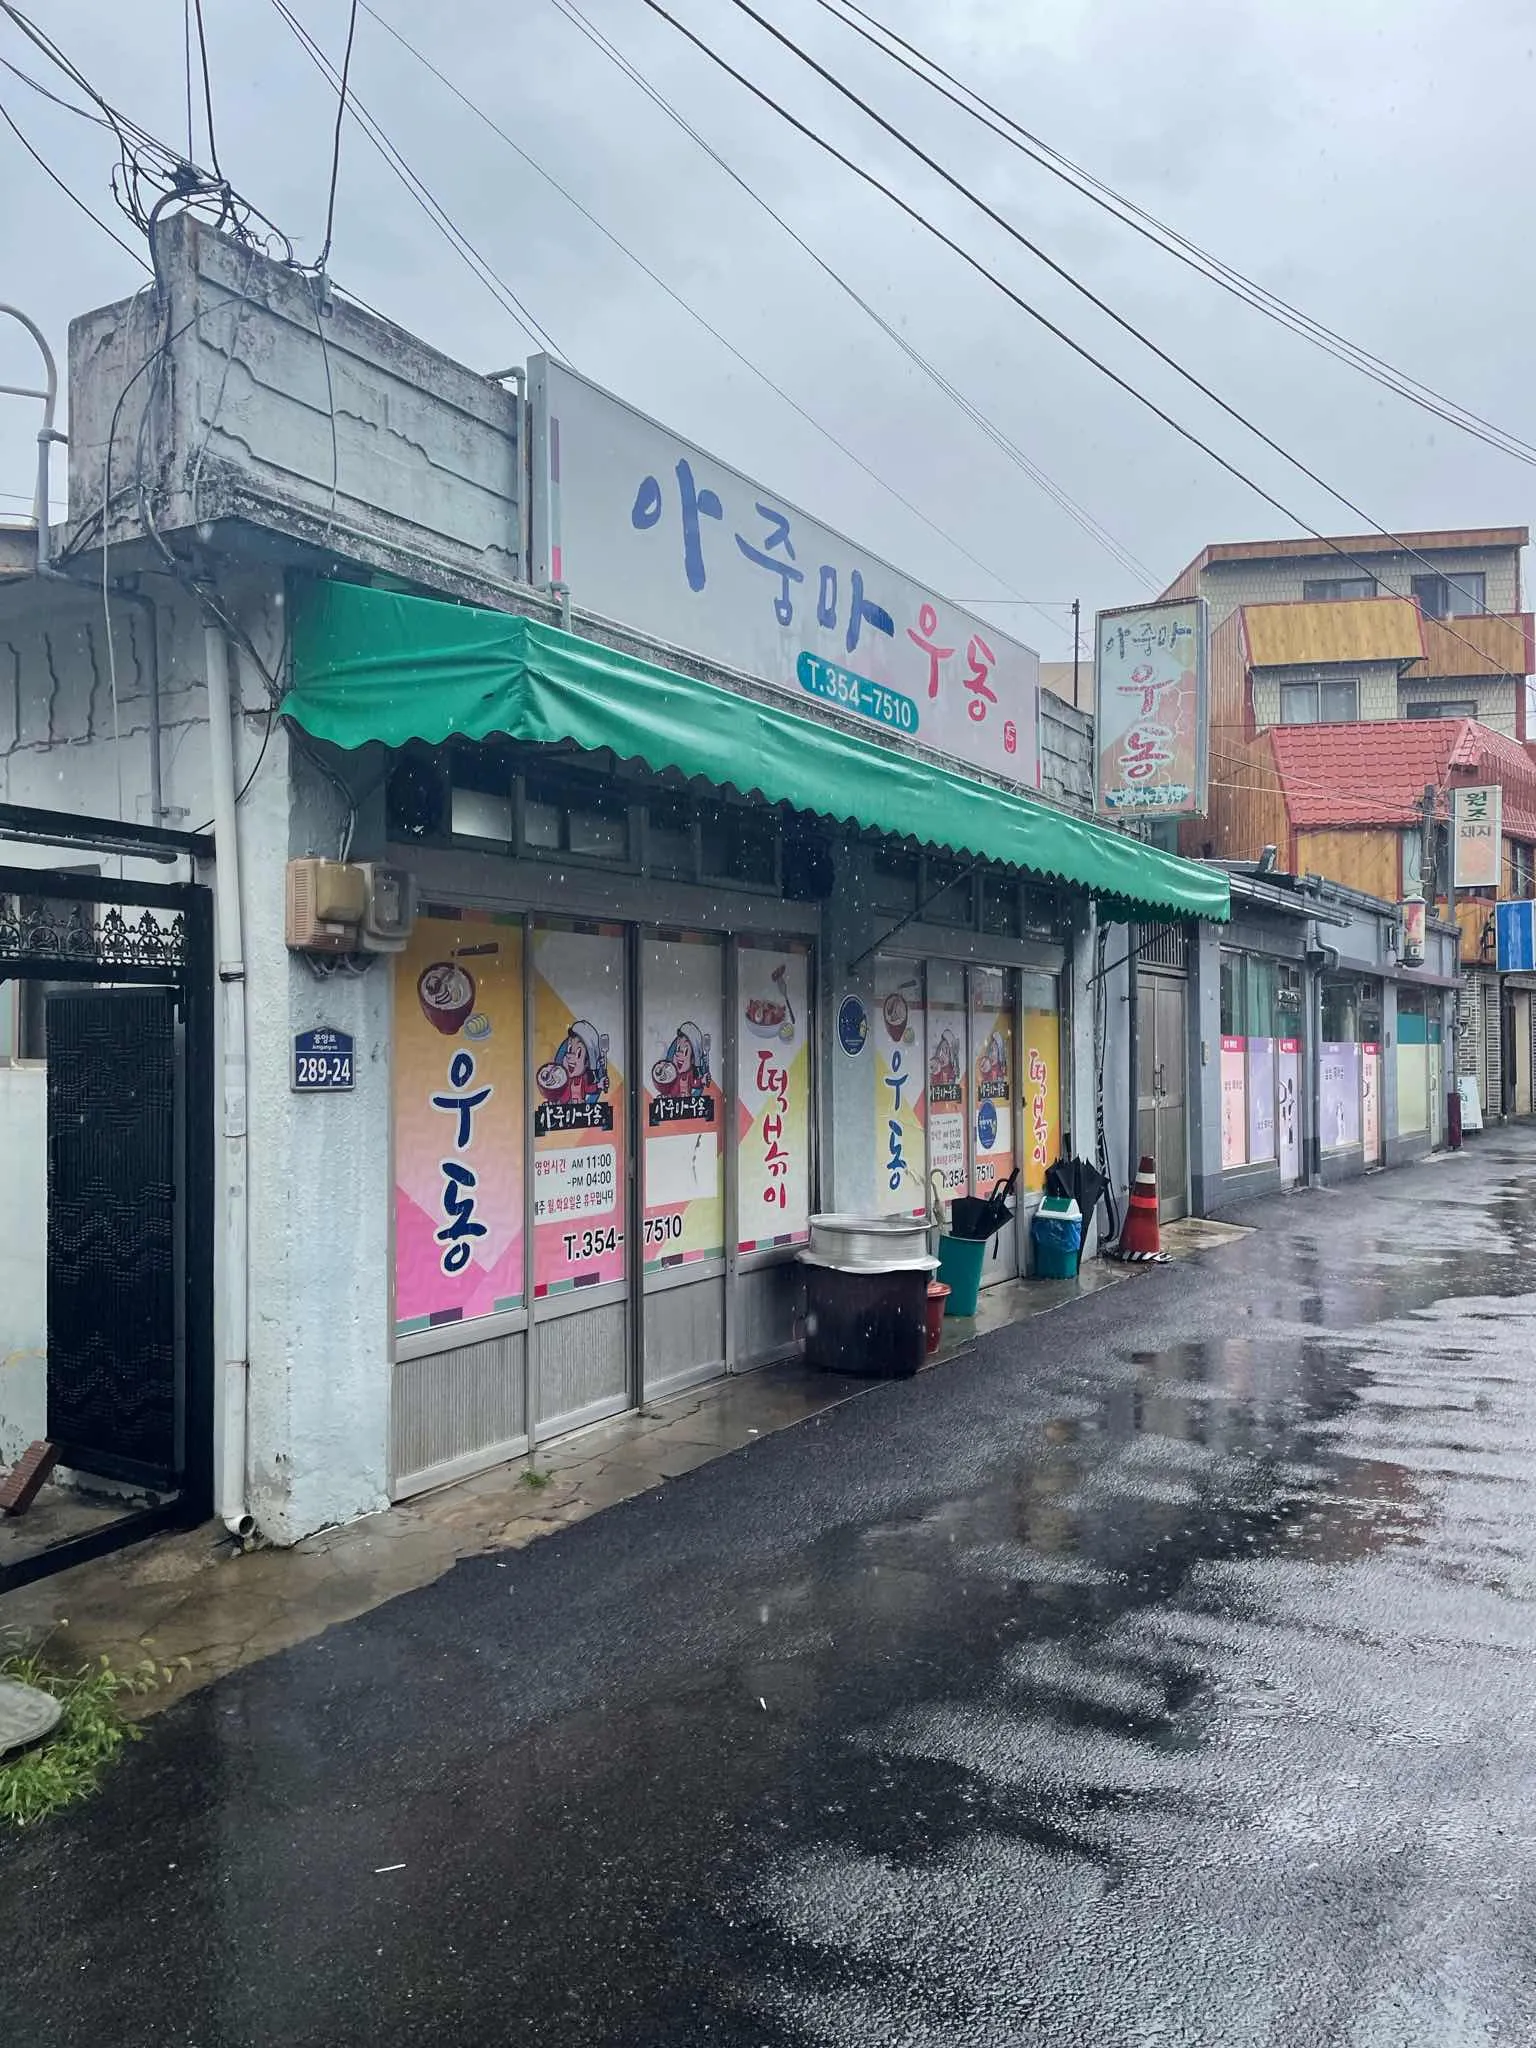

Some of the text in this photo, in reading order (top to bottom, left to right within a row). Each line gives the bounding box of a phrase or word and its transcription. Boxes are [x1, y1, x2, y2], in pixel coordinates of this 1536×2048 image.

[906, 603, 997, 721] 우동
[806, 659, 912, 728] T.354-7510
[1117, 664, 1174, 779] 우동
[1463, 790, 1487, 822] 원조
[1460, 824, 1491, 838] 돼지
[313, 1034, 337, 1045] 중앙로
[298, 1057, 350, 1082] 289-24
[885, 1050, 908, 1191] 우동
[1030, 1049, 1047, 1164] 떡볶이
[756, 1050, 789, 1209] 떡볶이
[432, 1052, 491, 1270] 우동
[535, 1153, 611, 1176] 영업시간 AM 11:00
[587, 1170, 612, 1186] 04:00
[584, 1190, 613, 1207] 휴무입니다
[644, 1215, 682, 1243] 7510
